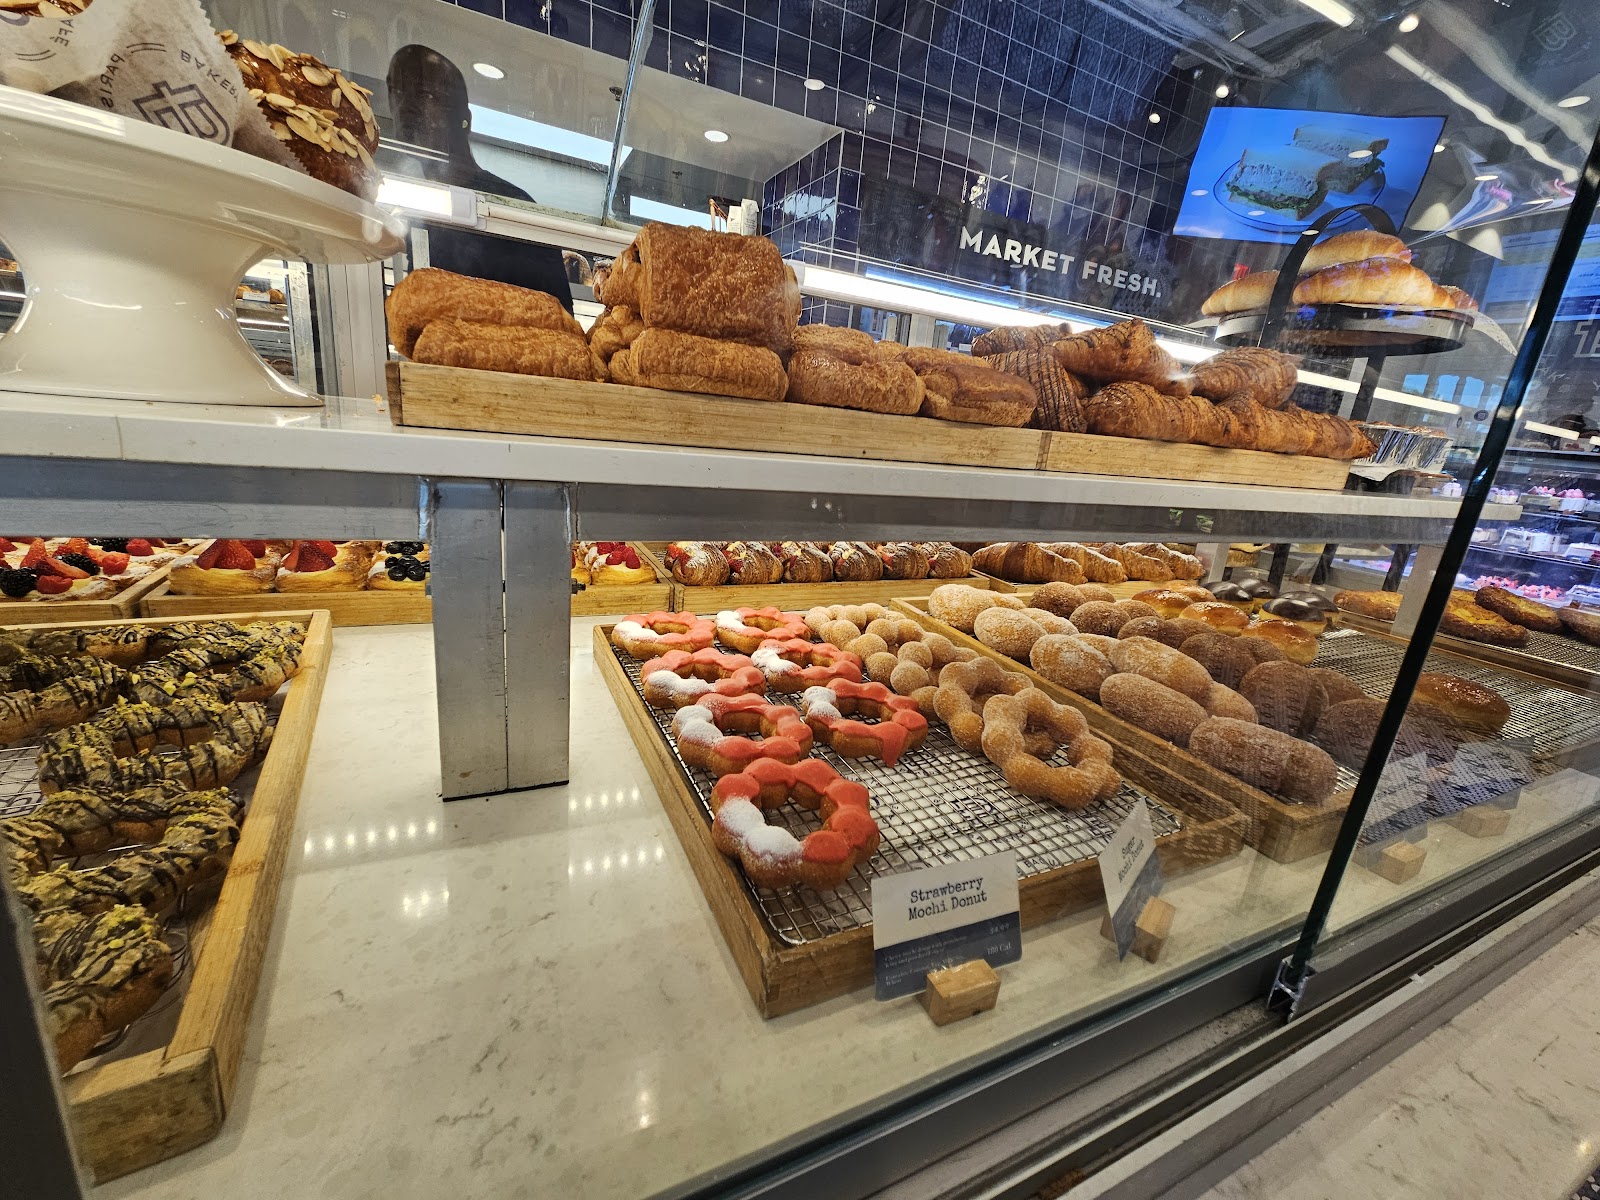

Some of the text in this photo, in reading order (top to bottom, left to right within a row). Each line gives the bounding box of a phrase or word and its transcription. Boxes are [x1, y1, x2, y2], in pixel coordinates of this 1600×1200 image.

[959, 226, 1162, 298] MARKET FRESH.
[908, 890, 988, 921] Mochi Donut
[910, 877, 984, 904] Strawberry
